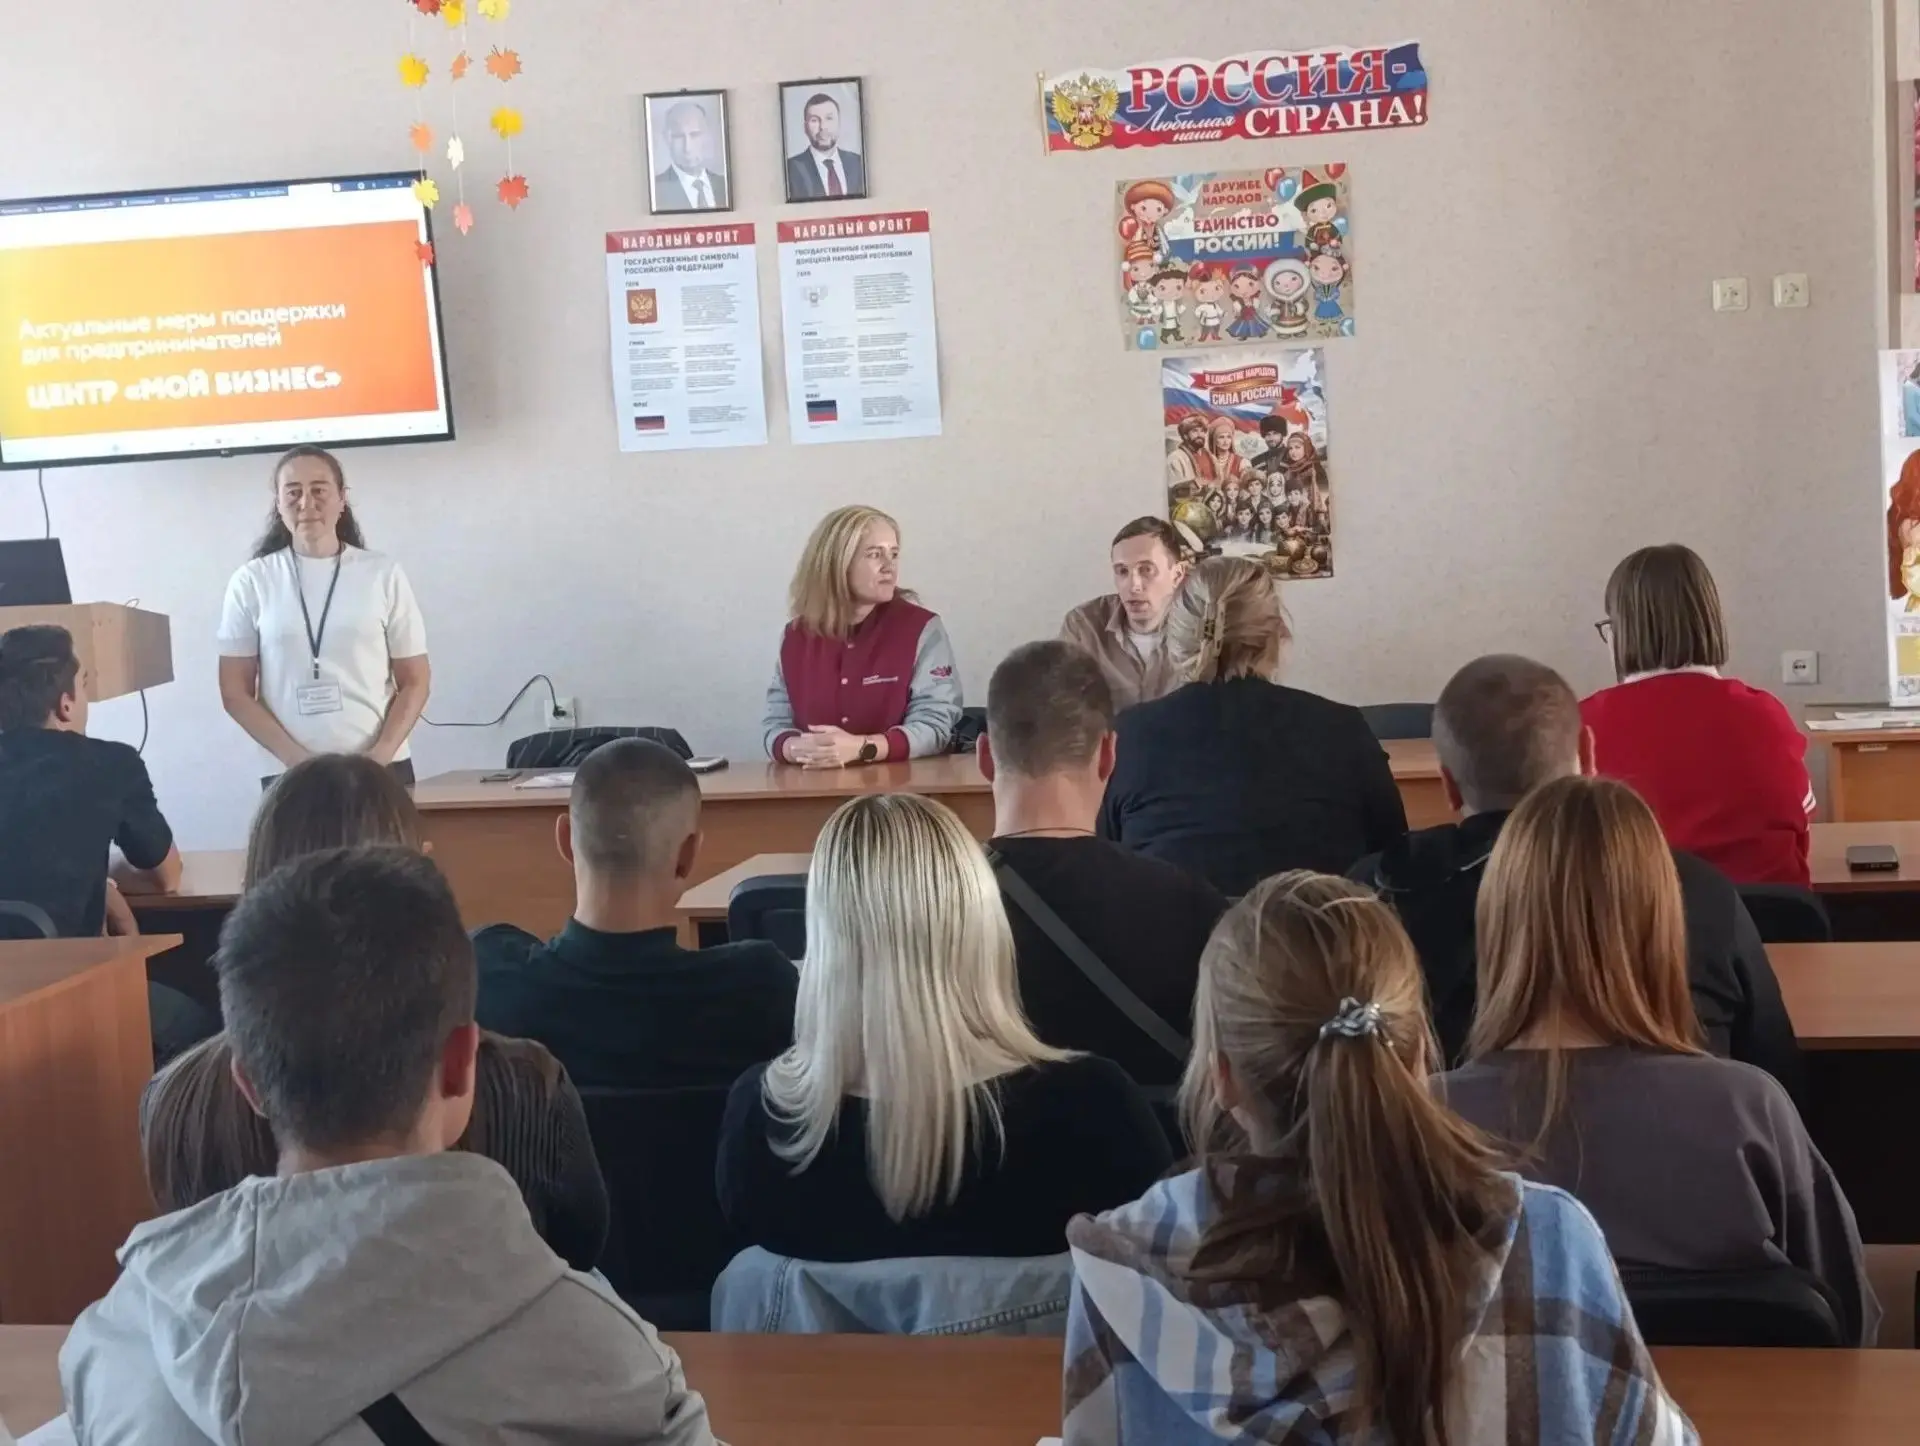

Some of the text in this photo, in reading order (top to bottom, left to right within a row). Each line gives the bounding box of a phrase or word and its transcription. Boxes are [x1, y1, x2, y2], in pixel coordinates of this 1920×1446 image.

[1125, 102, 1235, 135] Любимая
[1244, 95, 1423, 137] СТРАНА!
[1172, 128, 1222, 142] наша
[1202, 180, 1262, 193] В ДРУЖБЕ
[793, 218, 911, 238] НАРОДНЫЙ ФРОНТ
[1194, 214, 1279, 233] ЕДИНСТВО
[622, 229, 739, 249] НАРОДНЫЙ ФРОНТ
[860, 241, 894, 251] СИМВОЛЫ
[1194, 232, 1279, 254] РОССИИ!
[624, 251, 739, 266] ГОСУДАРСТВЕННЫЕ СИМВОЛЫ
[832, 252, 868, 262] НАРОДНОЙ
[869, 250, 912, 259] РЕСПУБЛИКИ
[625, 262, 723, 275] РОССИЙСКОЙ ФЕДЕРАЦИИ
[20, 304, 345, 341] Актуальные меры поддержки
[65, 324, 282, 363] предпринимателей
[26, 365, 342, 410] ЦЕНТР «МОЙ БИЗНЕС»
[1212, 385, 1282, 406] СИЛА РОССИИ!
